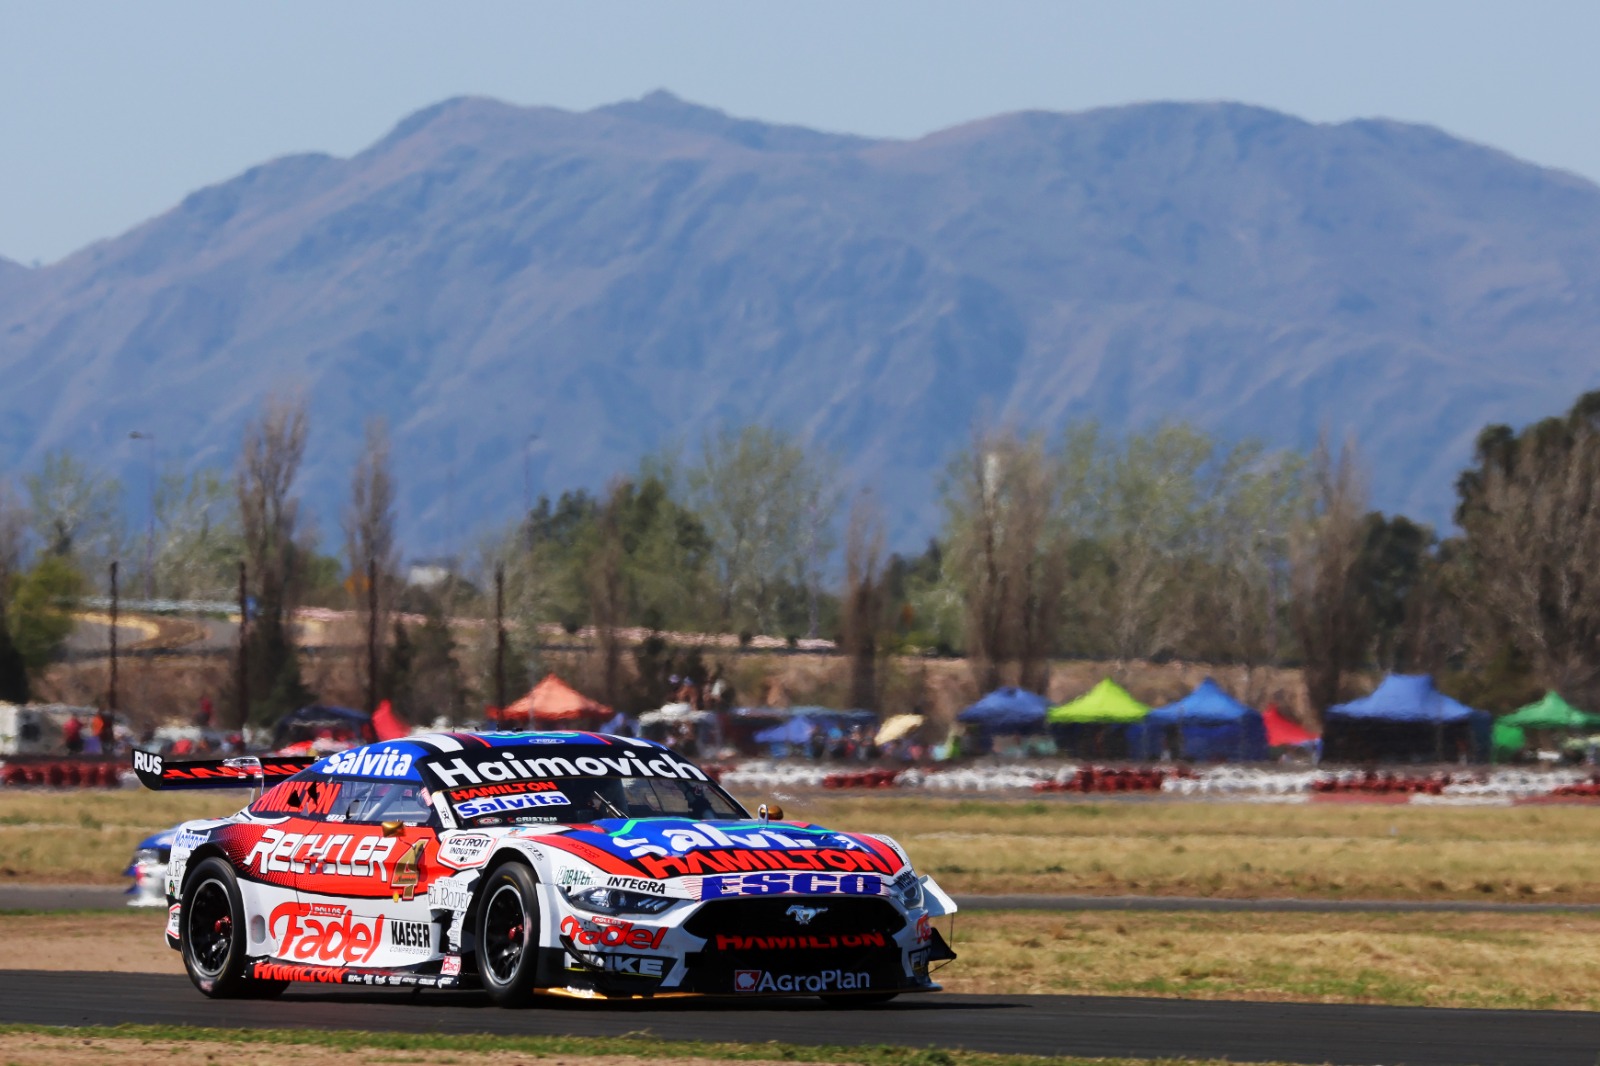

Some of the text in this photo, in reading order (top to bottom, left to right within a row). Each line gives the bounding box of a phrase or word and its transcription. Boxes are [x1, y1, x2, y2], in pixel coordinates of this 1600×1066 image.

[134, 751, 163, 776] RUS
[322, 747, 413, 777] Salvita
[428, 750, 709, 787] Haimovich
[450, 781, 558, 801] HAMILTON
[458, 794, 569, 817] Salvita
[448, 838, 491, 848] DETROIT
[391, 838, 430, 901] 4
[637, 848, 894, 880] HAMILTON
[607, 876, 666, 895] INTEGRA
[702, 872, 882, 897] ESCO
[268, 901, 385, 964] Fadel
[391, 920, 431, 948] KAESER
[560, 915, 670, 950] Fadel
[715, 931, 885, 951] HAMILTON
[253, 962, 348, 984] HAMILTON
[758, 969, 870, 992] AgroPlan
